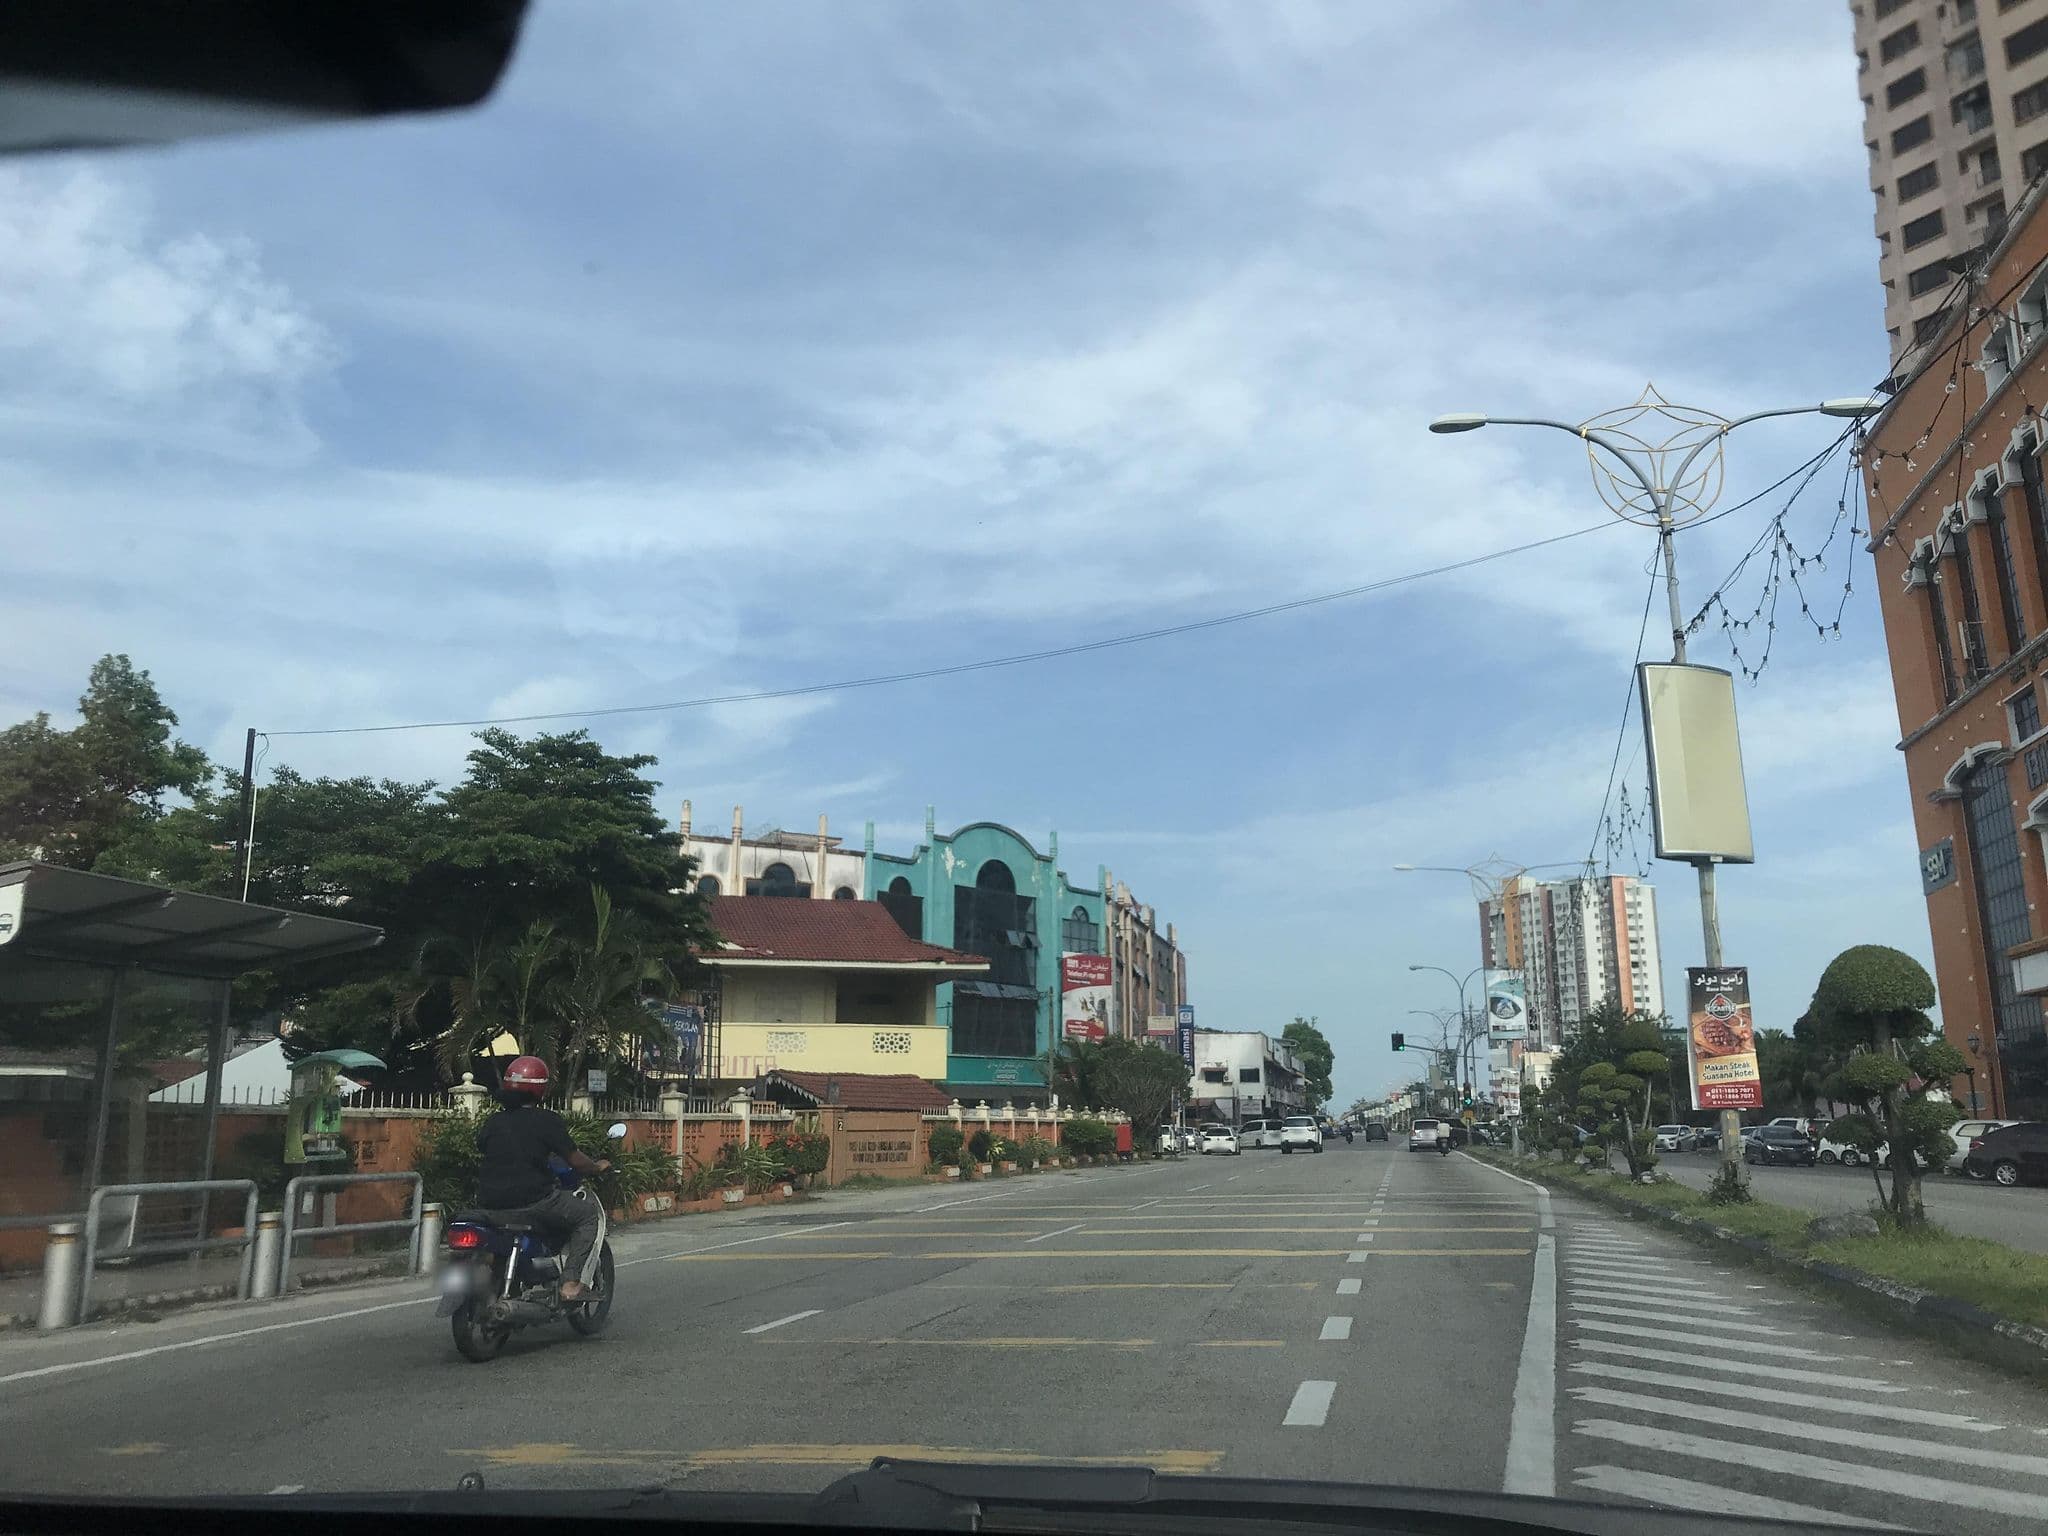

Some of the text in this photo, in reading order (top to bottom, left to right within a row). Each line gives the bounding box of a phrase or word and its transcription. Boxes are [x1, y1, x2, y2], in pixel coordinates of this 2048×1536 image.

[1182, 1028, 1190, 1062] armasi
[1729, 1061, 1751, 1069] Steak
[1702, 1070, 1754, 1080] Suasana Hotel
[837, 1121, 843, 1131] 2
